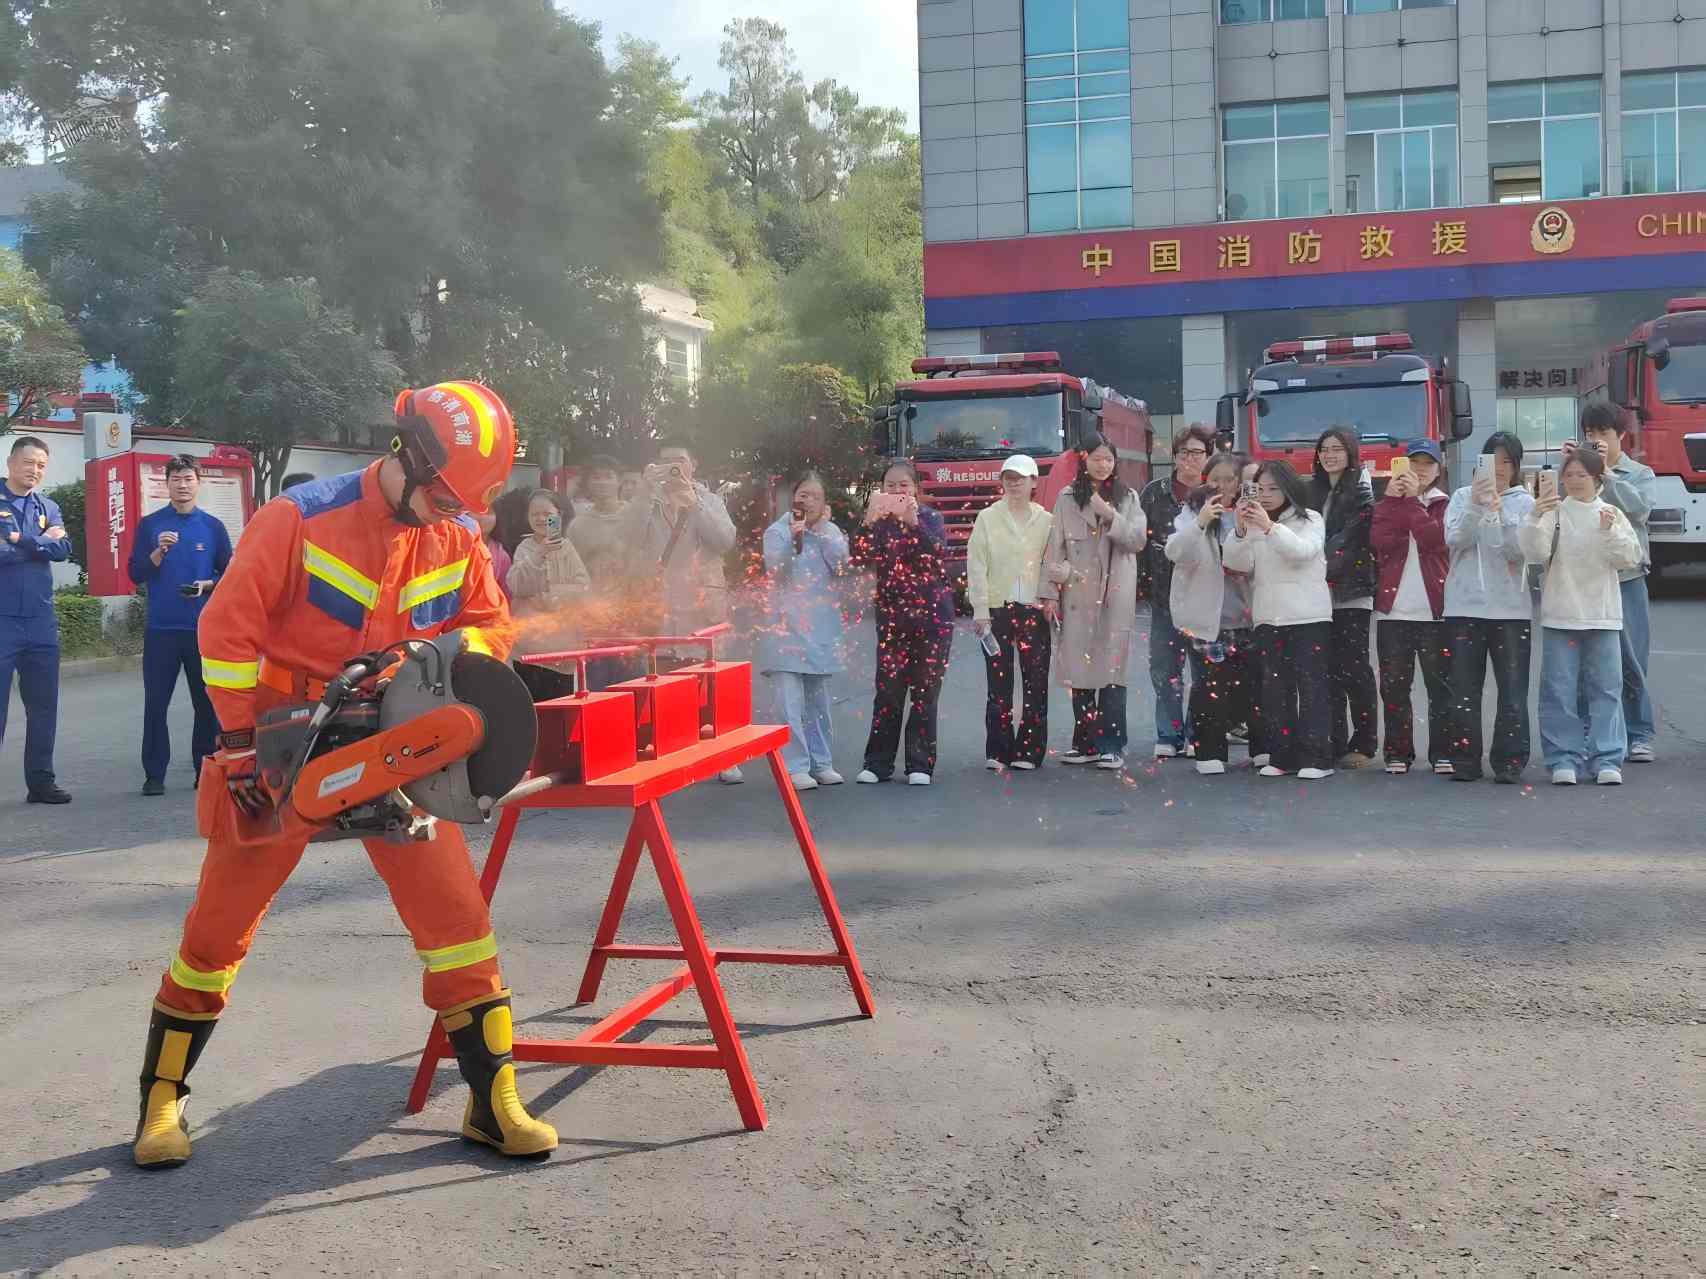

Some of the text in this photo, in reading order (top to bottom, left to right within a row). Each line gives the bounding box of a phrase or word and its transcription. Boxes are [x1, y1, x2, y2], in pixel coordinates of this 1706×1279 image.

[1081, 220, 1468, 277] 中国消防救援
[953, 471, 1001, 482] RESCUE
